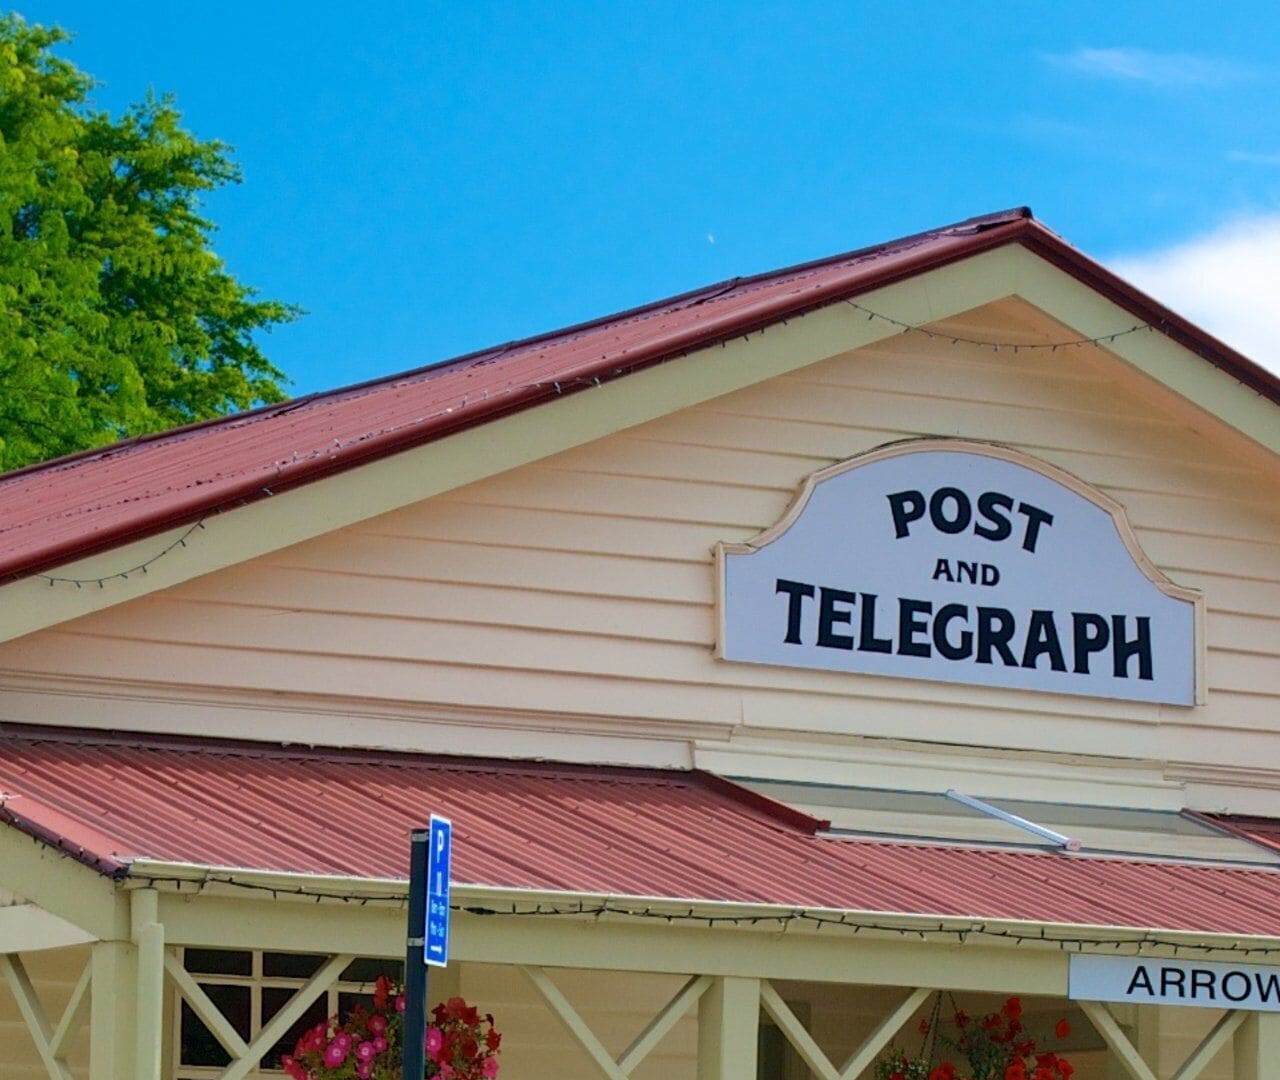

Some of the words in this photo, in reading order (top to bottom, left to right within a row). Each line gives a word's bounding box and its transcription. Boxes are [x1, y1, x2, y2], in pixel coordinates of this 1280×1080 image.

[886, 486, 1053, 554] POST
[931, 558, 1000, 587] AND
[775, 578, 1154, 681] TELEGRAPH
